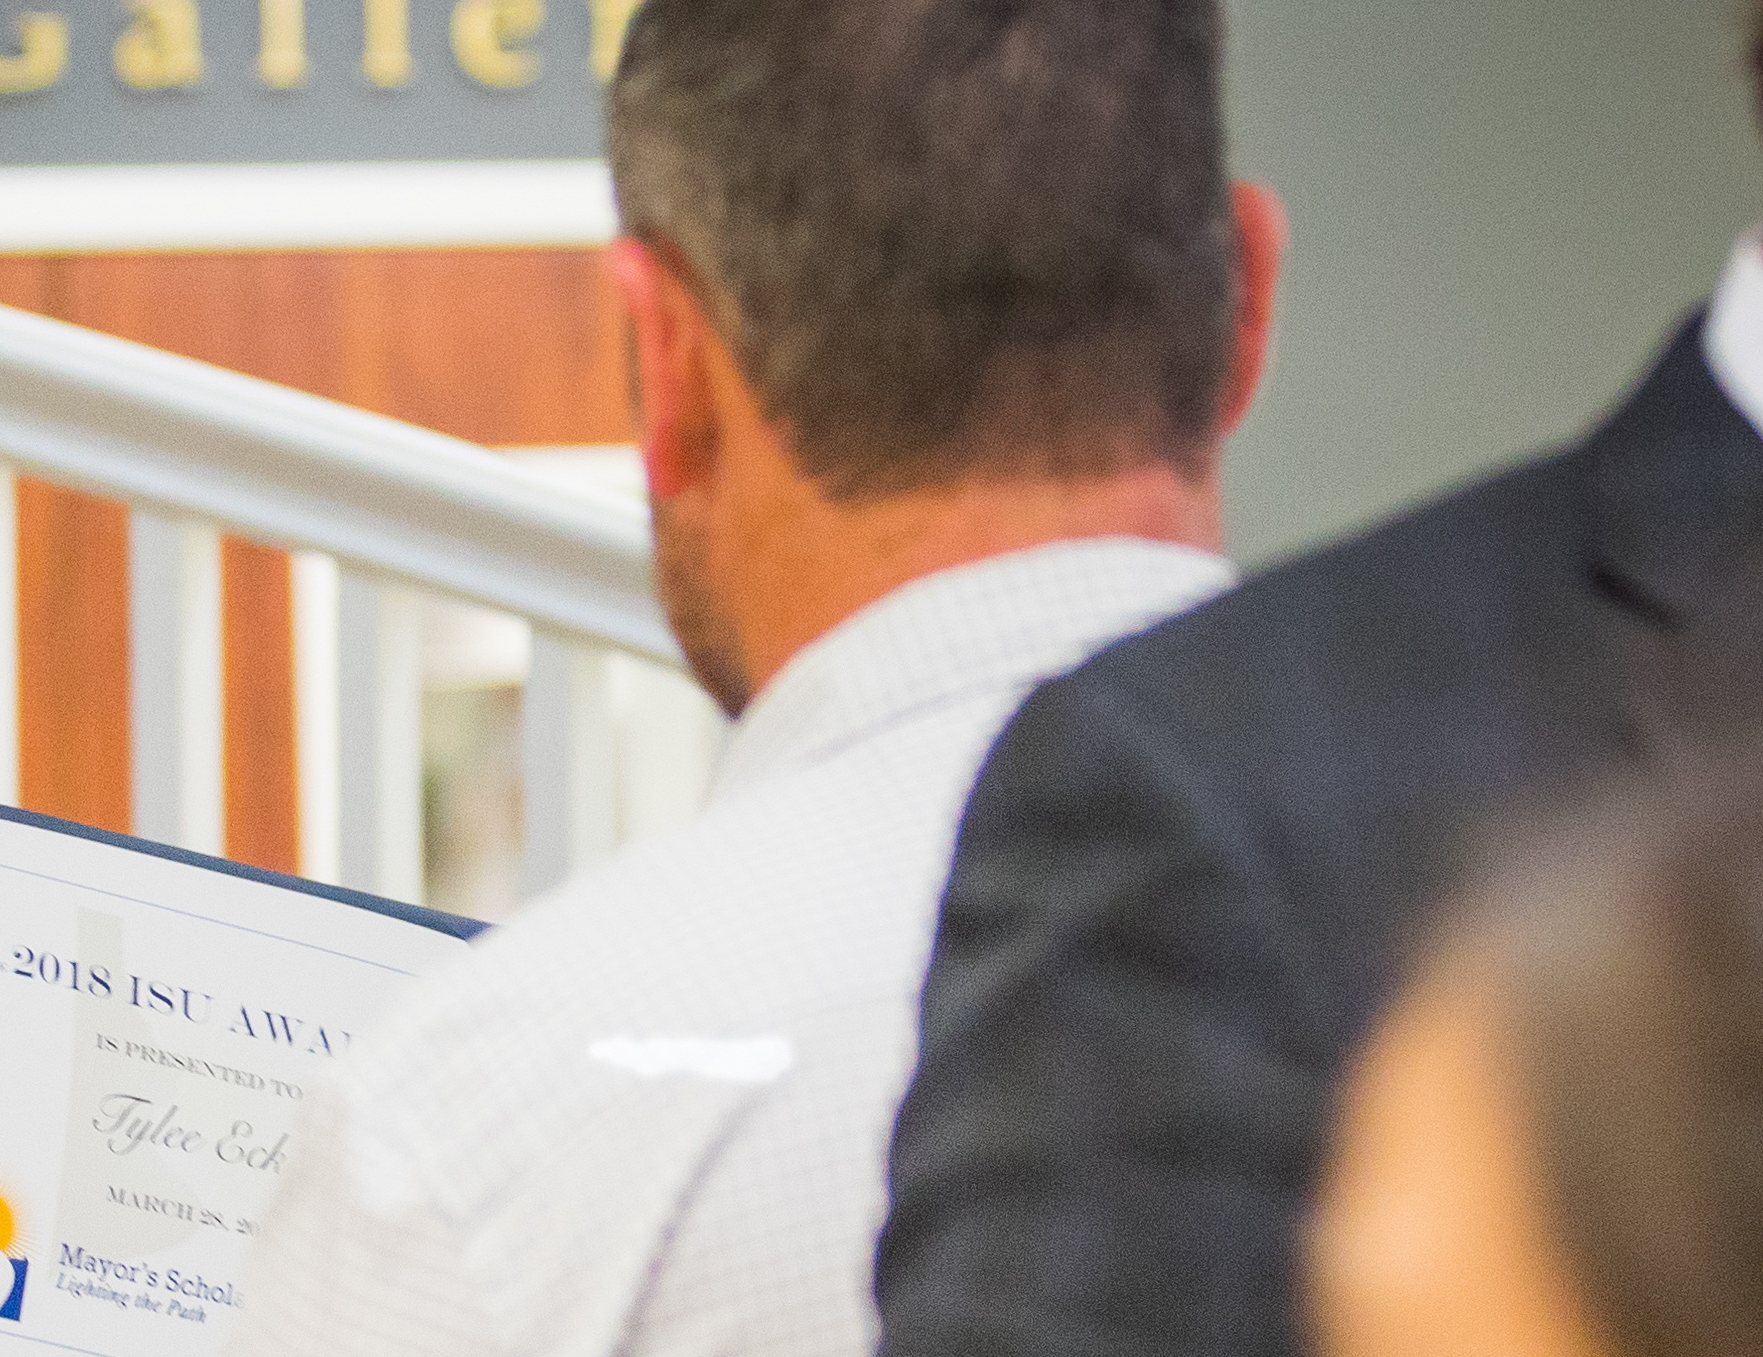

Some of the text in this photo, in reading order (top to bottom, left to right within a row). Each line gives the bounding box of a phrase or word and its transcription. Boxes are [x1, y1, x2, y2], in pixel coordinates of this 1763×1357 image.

[13, 945, 112, 999] 2018
[128, 974, 213, 1024] ISU
[96, 1033, 304, 1101] IS PRESENTED TO
[92, 1093, 202, 1156] Tylee
[107, 1185, 193, 1222] MARCH
[58, 1242, 159, 1288] Mayor's
[56, 1272, 207, 1324] Lighting the Path
